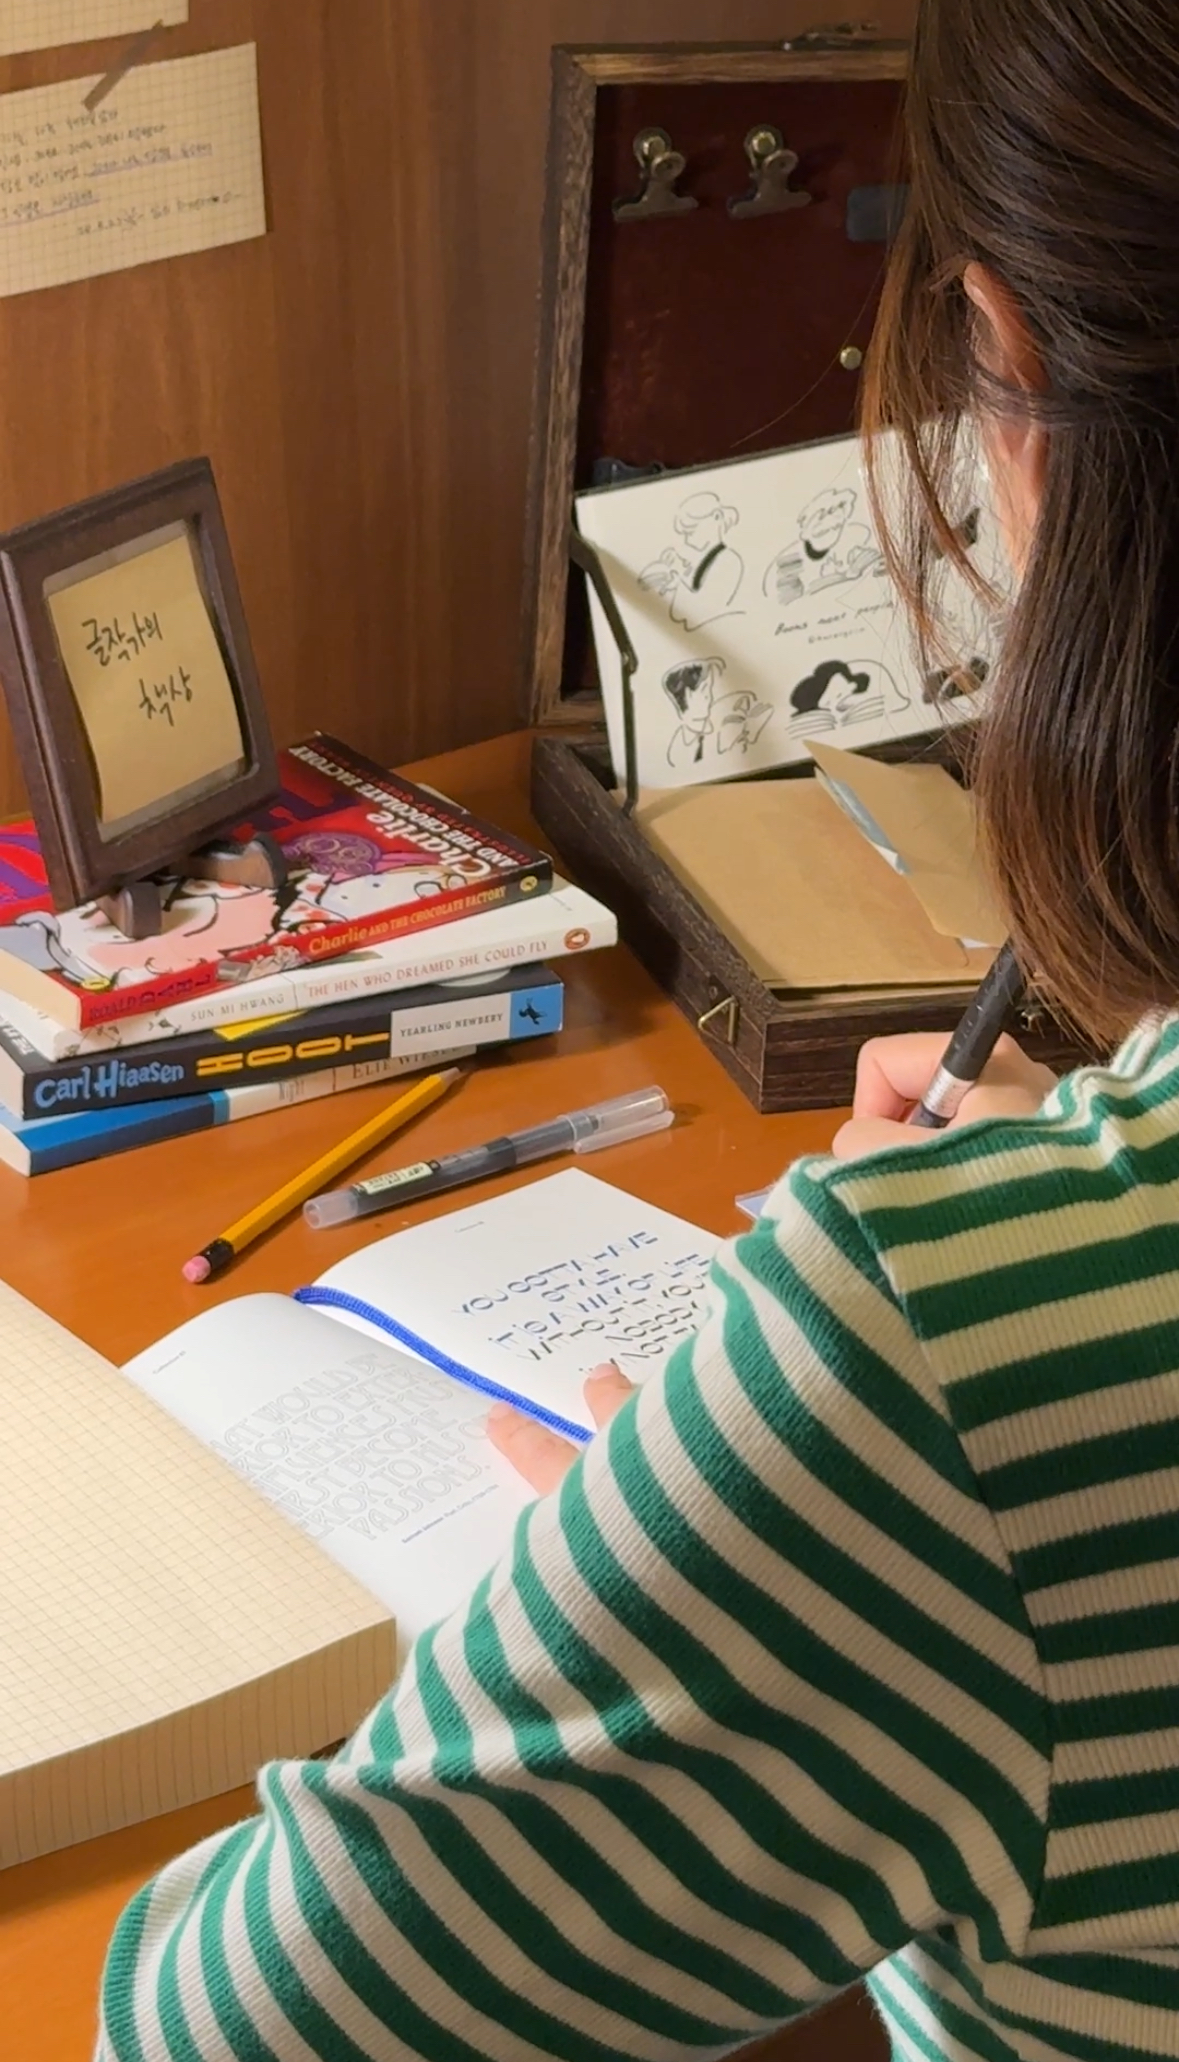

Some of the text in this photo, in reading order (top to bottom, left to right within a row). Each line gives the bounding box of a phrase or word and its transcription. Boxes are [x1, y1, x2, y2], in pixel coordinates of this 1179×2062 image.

[139, 666, 193, 727] 책상
[288, 746, 363, 787] FACTORY
[354, 783, 449, 832] CHOCOLATE
[366, 811, 491, 877] Charlie
[442, 829, 482, 850] THE
[477, 847, 519, 867] AND
[309, 886, 507, 954] Charlie AND THE CHOCOLATE FACTORY
[190, 939, 549, 1021] SUN MI HWANG THE HEN WHO DREAMED SHE COULD FLY
[400, 1012, 504, 1038] YEARLING NEWBERY
[34, 1031, 390, 1108] Carl Hiaasen HOOT
[352, 1060, 392, 1079] ELIE
[452, 1287, 509, 1316] YOU
[251, 1369, 359, 1425] WOULD
[291, 1404, 345, 1434] TO
[334, 1408, 458, 1478] BECOME
[368, 1459, 422, 1488] TO
[409, 1431, 466, 1467] HIS
[347, 1455, 491, 1541] PASSIONS.
